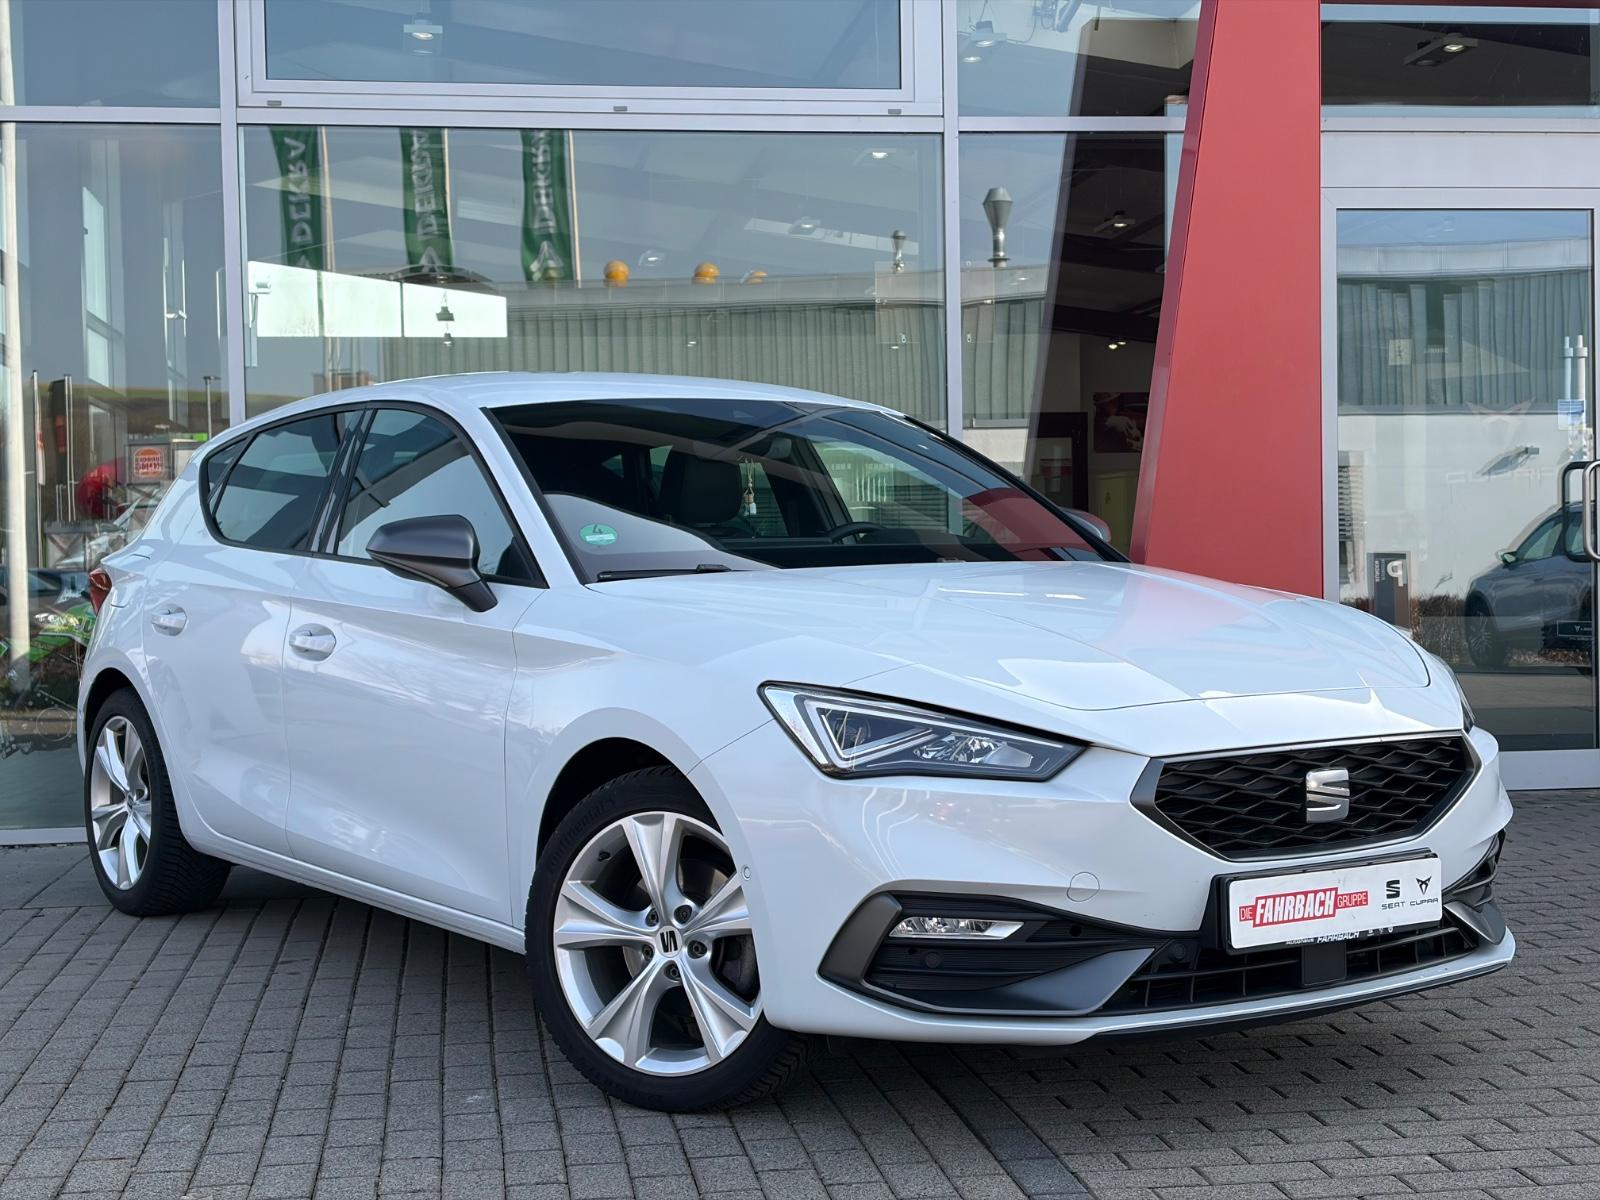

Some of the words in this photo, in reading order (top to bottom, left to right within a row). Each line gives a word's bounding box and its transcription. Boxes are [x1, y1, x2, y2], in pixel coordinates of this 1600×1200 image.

[592, 523, 603, 535] 4
[1240, 906, 1253, 920] DIE
[1255, 890, 1336, 925] FAHRBACH
[1337, 892, 1367, 907] GRUPPE
[1381, 901, 1405, 910] SEAT
[1409, 897, 1439, 906] CUPRA
